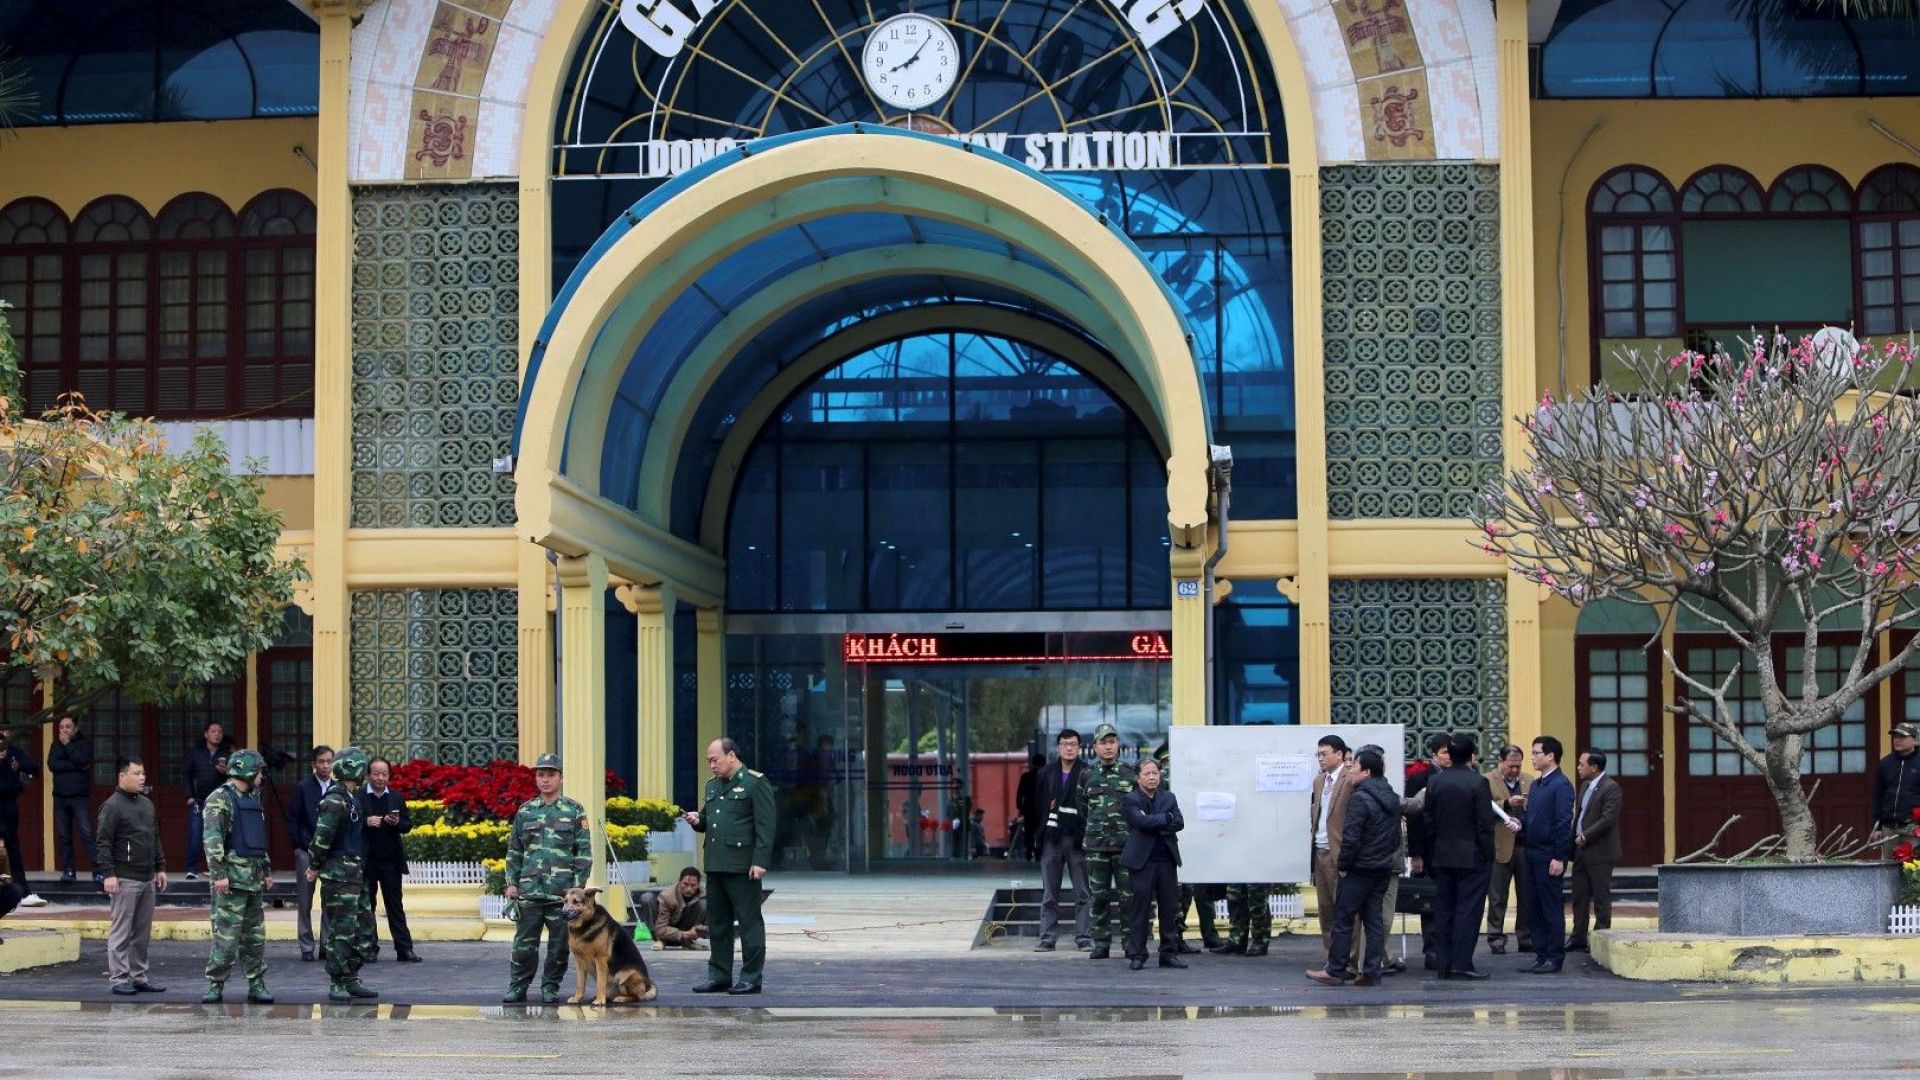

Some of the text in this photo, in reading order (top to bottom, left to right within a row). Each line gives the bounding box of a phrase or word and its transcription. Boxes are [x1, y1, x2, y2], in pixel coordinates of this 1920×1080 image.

[890, 29, 899, 40] 11
[905, 24, 917, 35] 12
[877, 41, 888, 52] 10
[936, 40, 944, 52] 2
[876, 57, 884, 68] 9
[940, 56, 948, 66] 3
[880, 73, 888, 84] 8
[936, 73, 942, 84] 4
[892, 84, 899, 96] 7
[908, 88, 916, 99] 6
[924, 84, 931, 95] 5
[1025, 131, 1171, 171] STATION
[1178, 582, 1197, 595] 62
[849, 633, 1169, 657] KHÁCH GA
